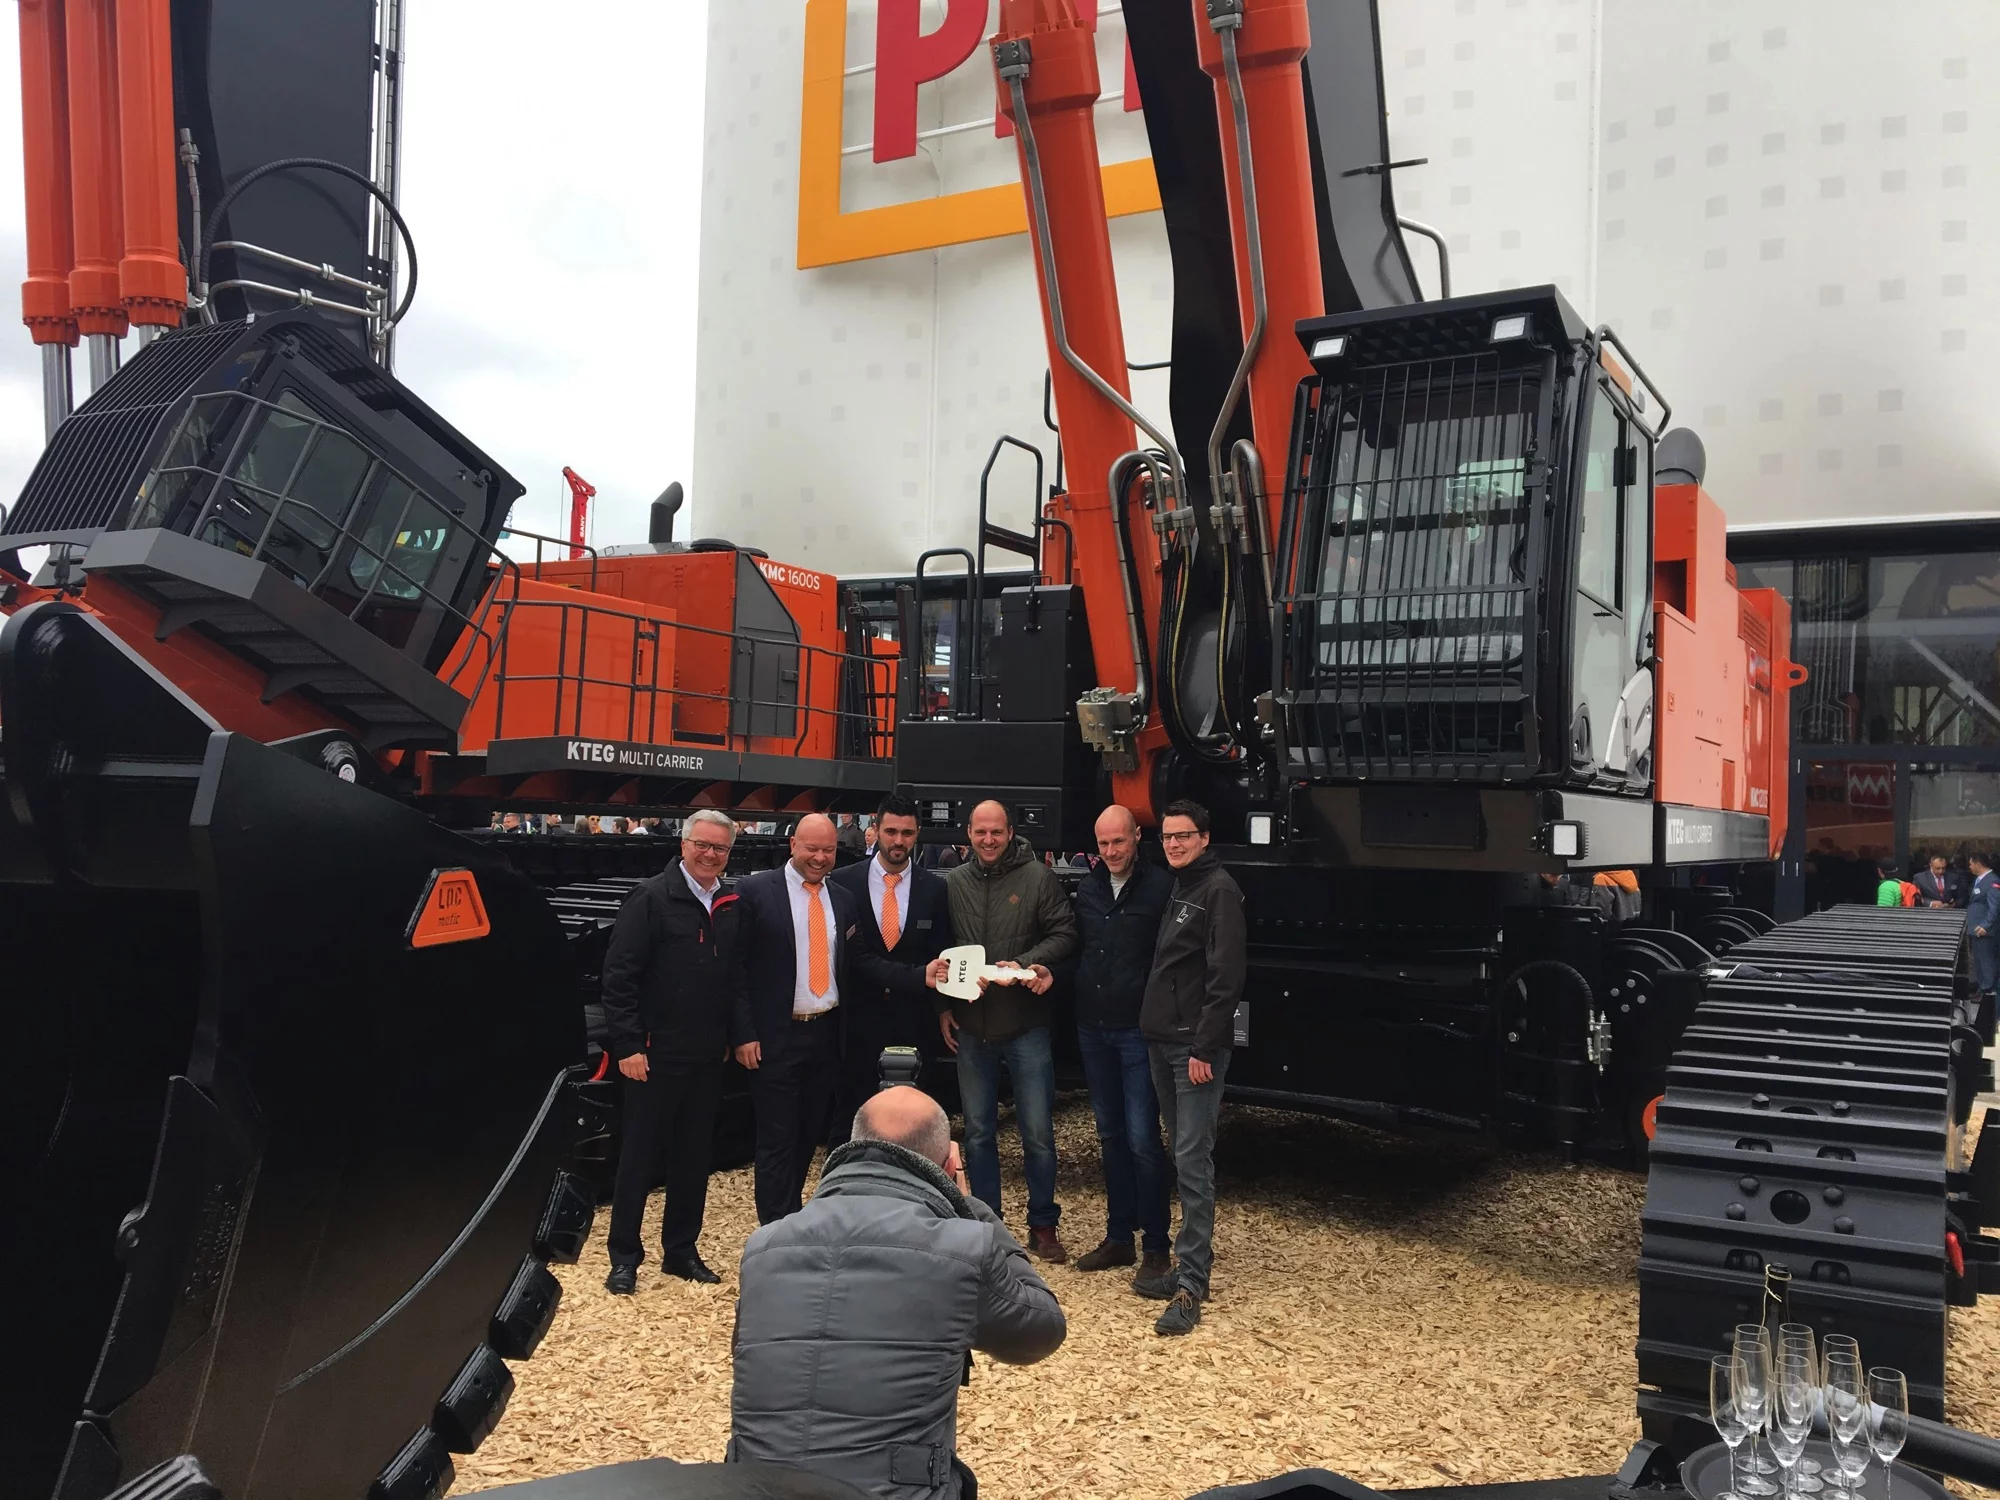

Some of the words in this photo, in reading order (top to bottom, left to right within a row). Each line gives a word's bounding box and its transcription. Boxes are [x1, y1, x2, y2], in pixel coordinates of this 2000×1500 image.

[759, 561, 786, 582] KMC
[787, 569, 820, 591] 1600S
[567, 741, 615, 763] KTEG
[619, 750, 654, 766] MULTI
[656, 753, 704, 770] CARRIER
[1667, 819, 1685, 844] KTEG
[958, 960, 967, 983] KTEG
